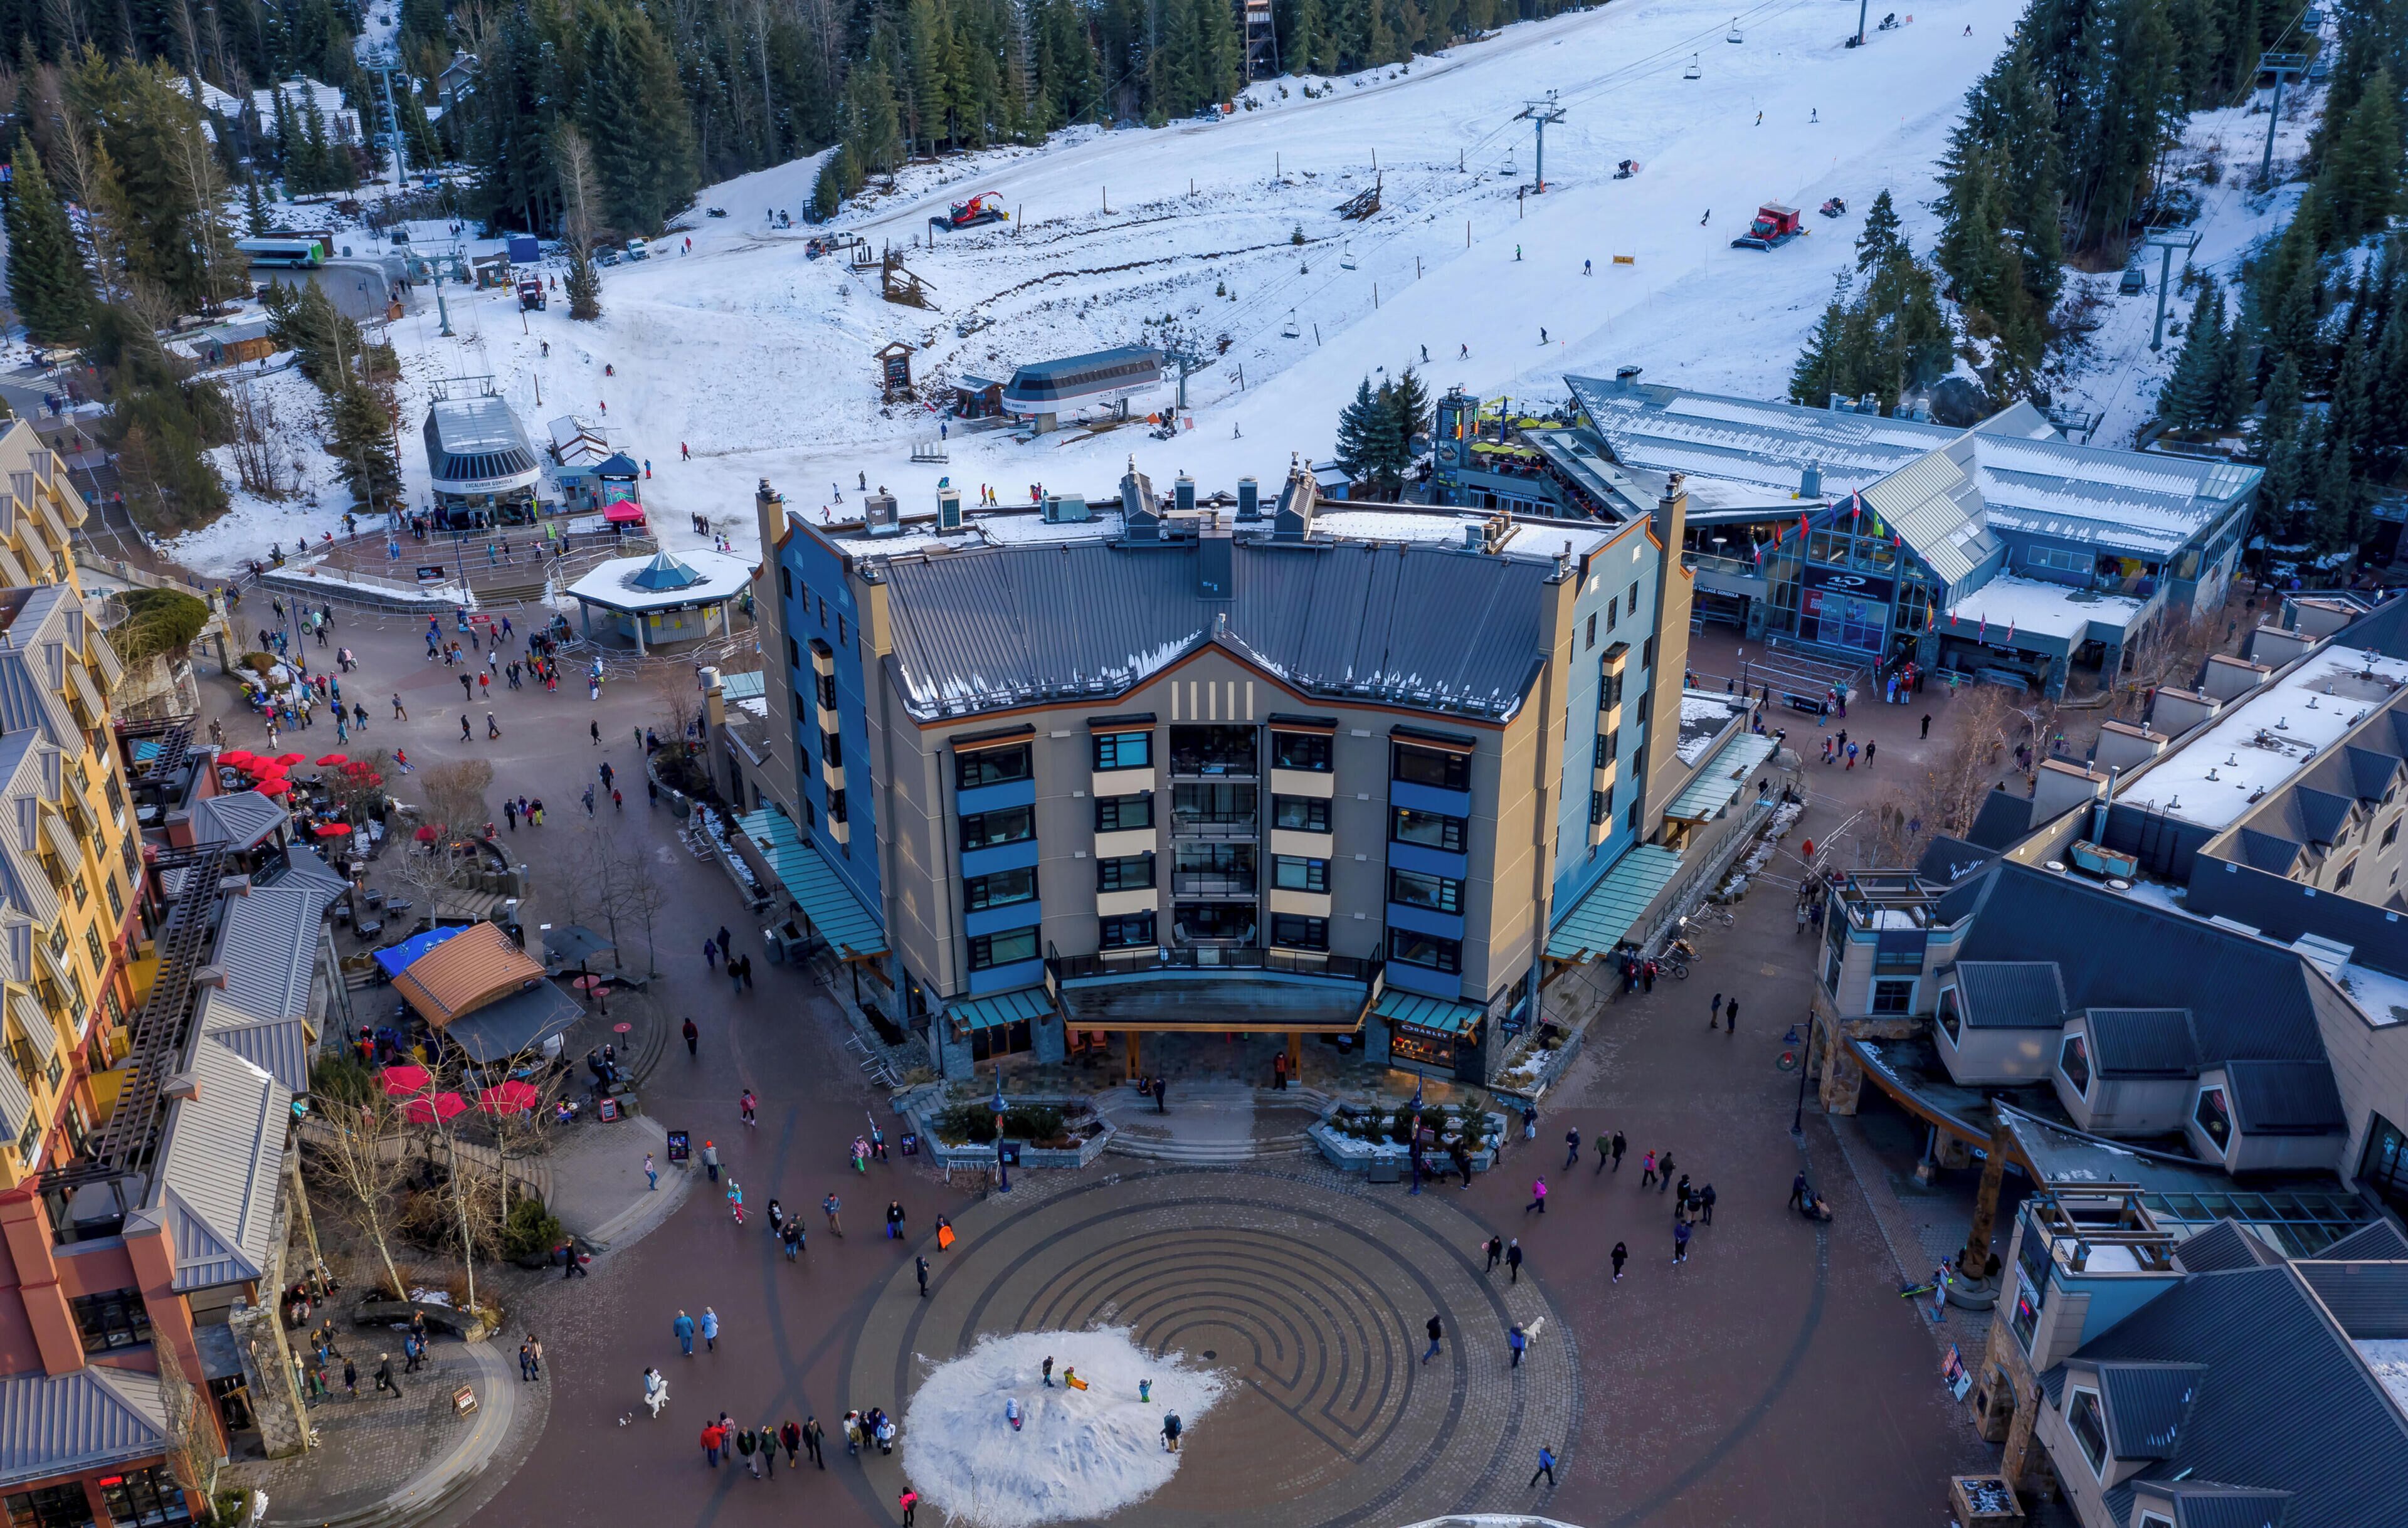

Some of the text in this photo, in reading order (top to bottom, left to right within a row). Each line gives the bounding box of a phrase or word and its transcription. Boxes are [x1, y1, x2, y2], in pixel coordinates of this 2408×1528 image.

[1116, 385, 1144, 395] Fitzsimmons
[1698, 585, 1716, 594] VILLAGE
[1717, 590, 1739, 598] GONDOLA
[1414, 1028, 1447, 1038] OAKLEY
[459, 1395, 474, 1408] SALE
